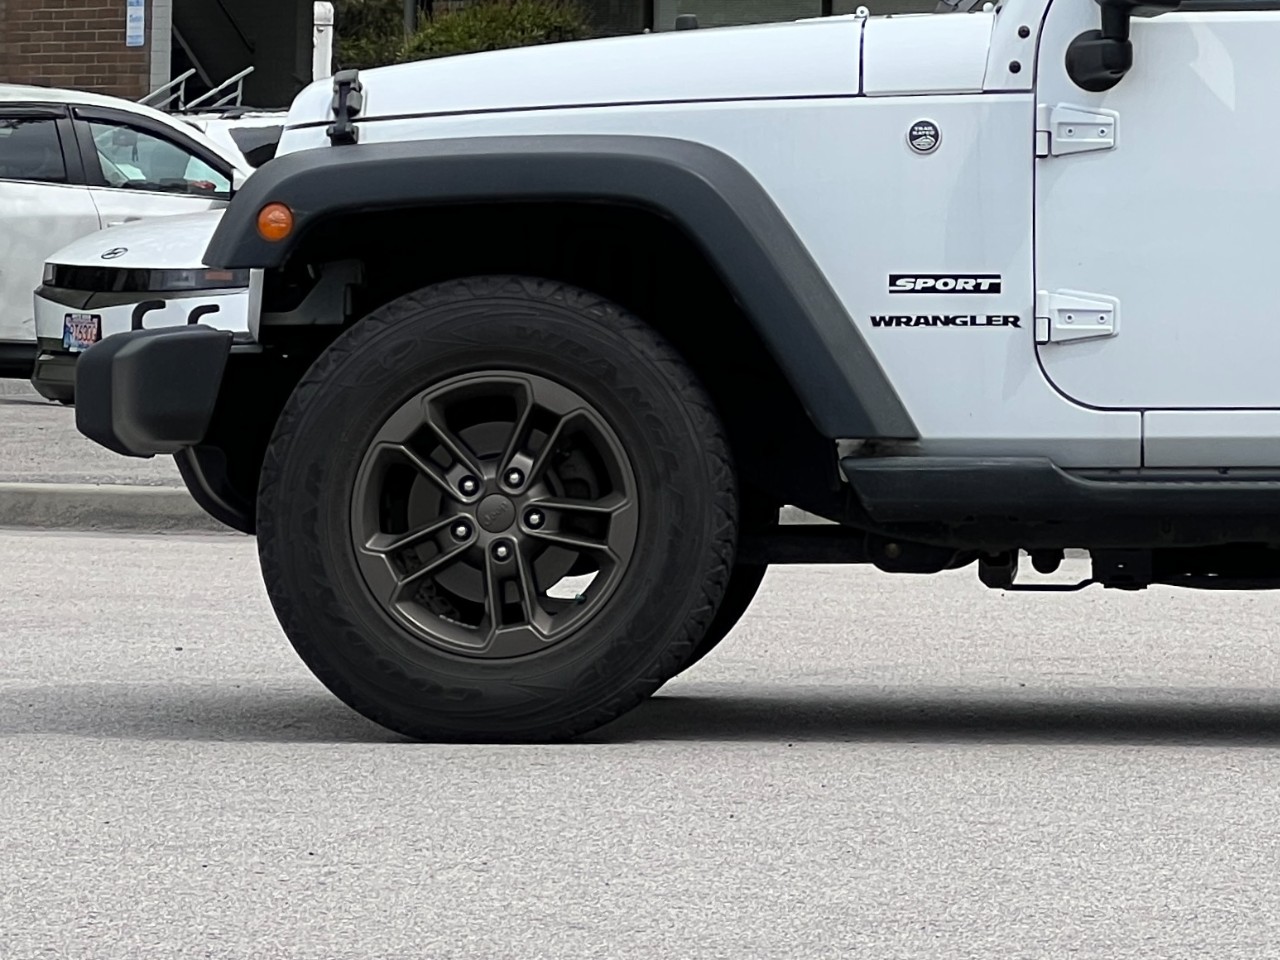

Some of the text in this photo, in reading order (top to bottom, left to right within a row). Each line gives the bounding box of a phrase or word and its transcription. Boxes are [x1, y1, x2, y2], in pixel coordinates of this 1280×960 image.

[889, 277, 1001, 291] SPORT
[870, 315, 1023, 328] WRANGLER
[483, 500, 508, 527] Jeep
